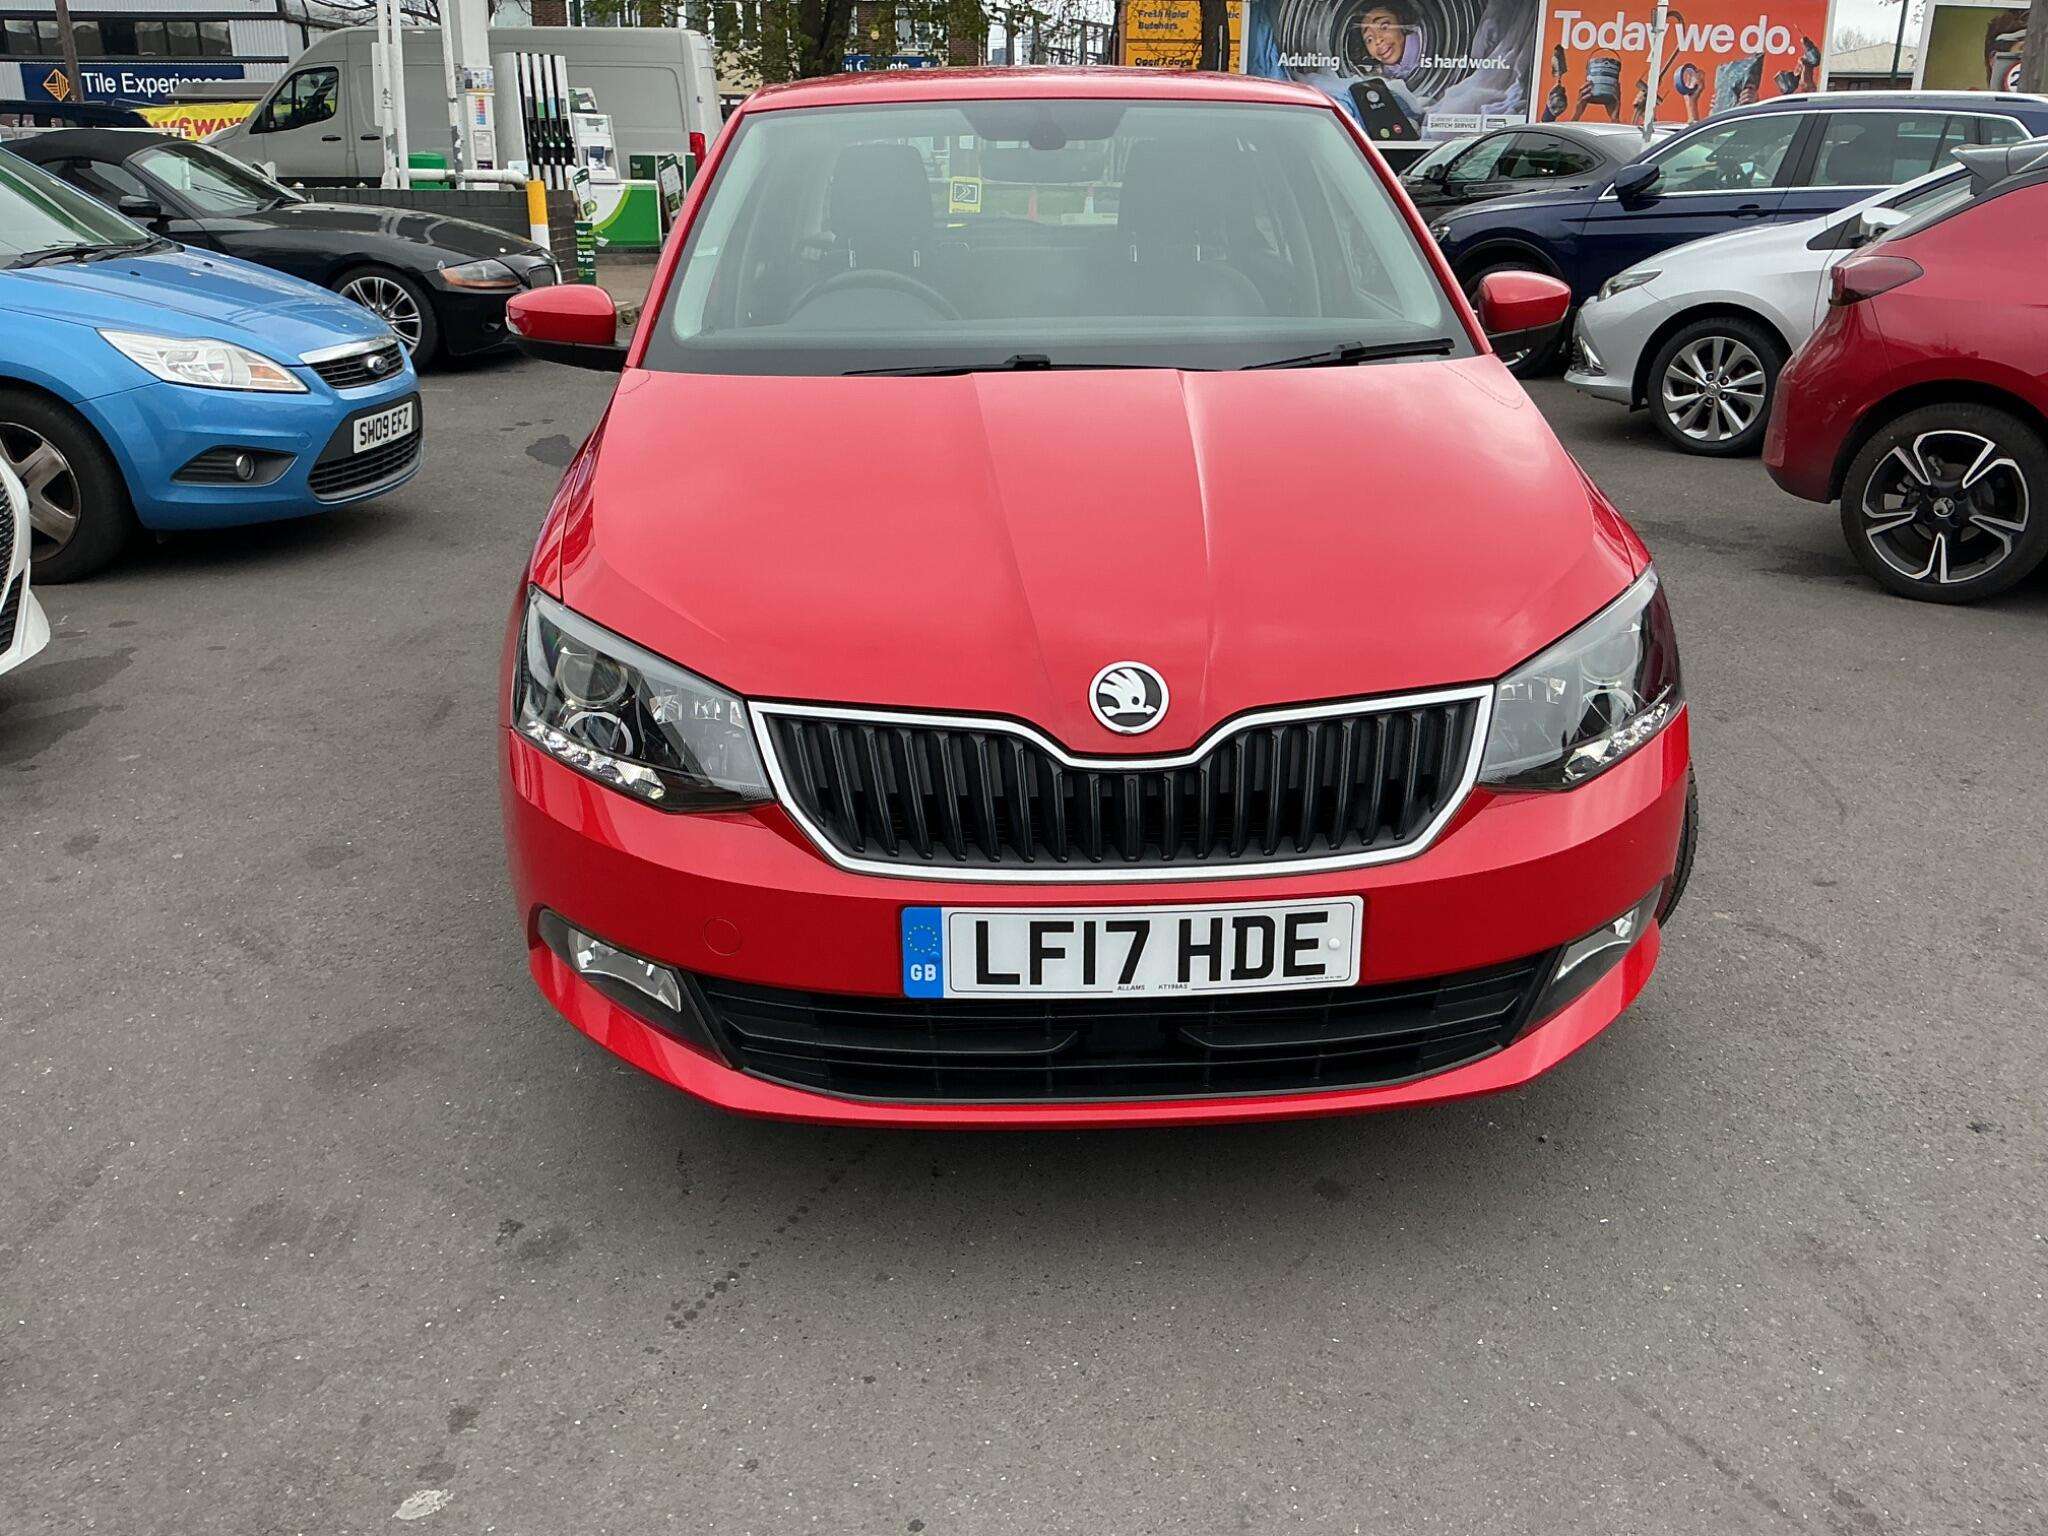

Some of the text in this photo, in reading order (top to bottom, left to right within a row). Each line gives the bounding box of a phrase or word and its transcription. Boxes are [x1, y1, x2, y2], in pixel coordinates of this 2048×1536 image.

[1554, 10, 1796, 62] Today we do.
[1277, 52, 1510, 71] Adulting is hard work.
[81, 72, 222, 98] Tile Experi
[359, 415, 390, 446] SH09
[976, 911, 1328, 985] LF17 HDE
[910, 963, 937, 982] GB
